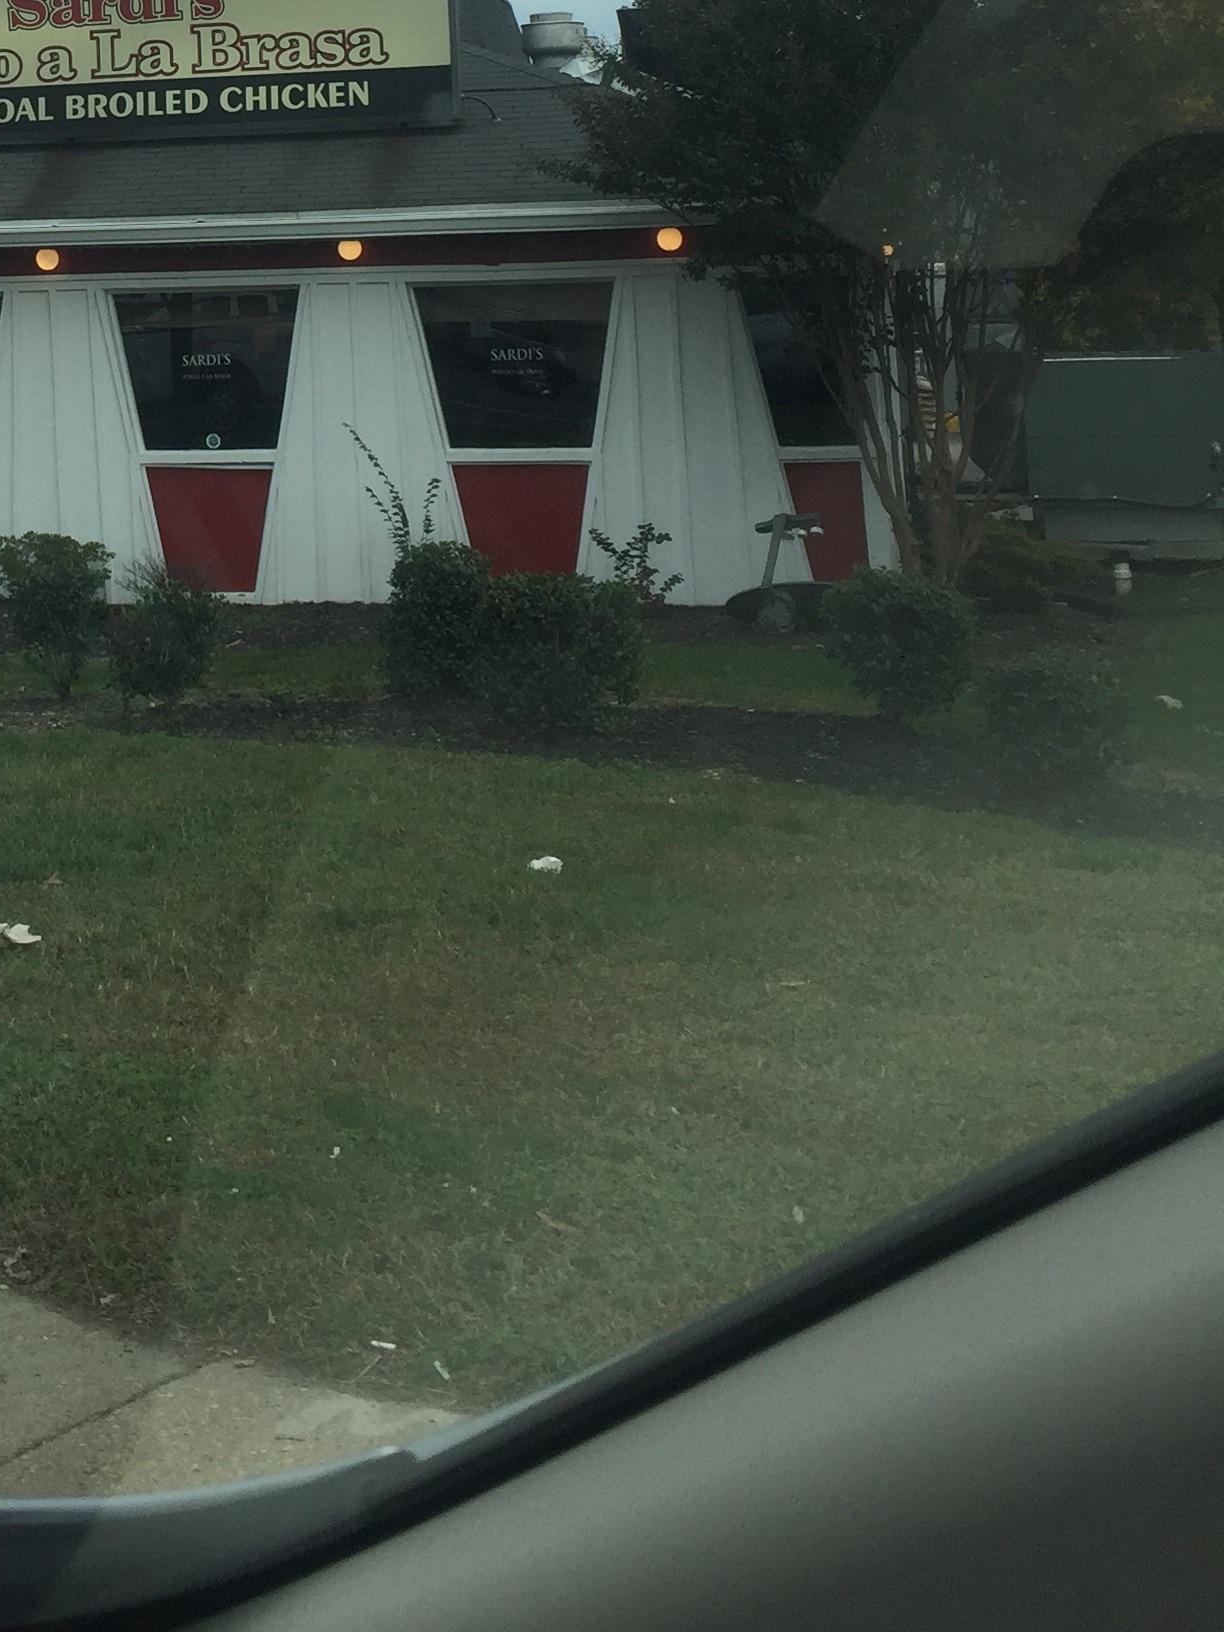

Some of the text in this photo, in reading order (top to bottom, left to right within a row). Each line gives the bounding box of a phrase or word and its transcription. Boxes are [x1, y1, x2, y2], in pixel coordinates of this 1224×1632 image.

[36, 45, 79, 83] a
[89, 28, 180, 80] La
[190, 22, 390, 74] Brasa
[65, 89, 209, 119] BROILED
[219, 80, 370, 113] CHICKEN
[182, 352, 232, 367] SARDI'S
[490, 347, 544, 361] SARDI'S
